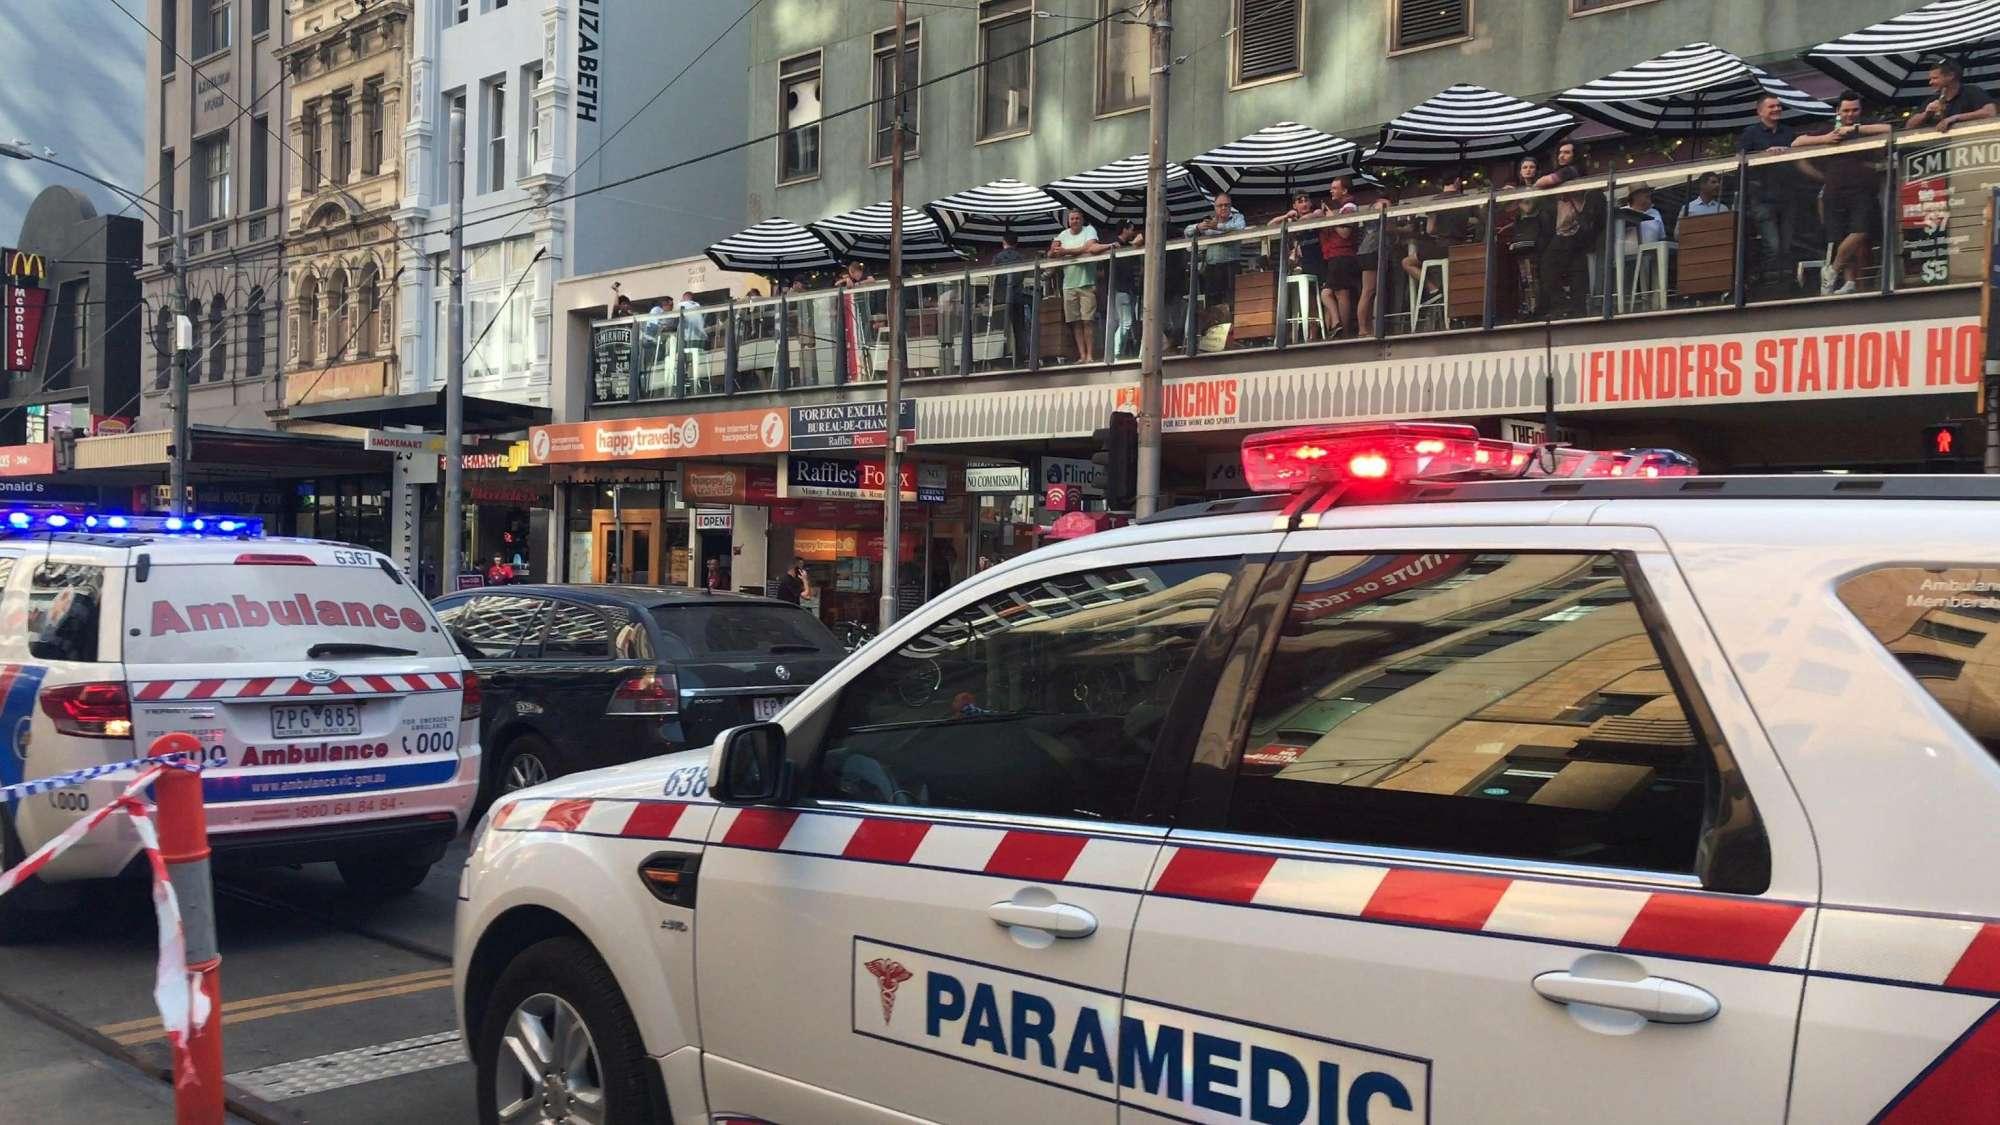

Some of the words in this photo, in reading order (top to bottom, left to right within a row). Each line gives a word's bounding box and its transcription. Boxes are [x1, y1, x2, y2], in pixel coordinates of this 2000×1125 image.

[1921, 260, 1948, 283] $5
[14, 288, 27, 366] McDonald's
[596, 330, 630, 347] SMIRNOFF
[1589, 342, 1743, 402] FLINDERS
[1755, 331, 1911, 393] STATION
[1163, 379, 1237, 418] UNCAN'S
[799, 407, 844, 422] FOREIGN
[372, 437, 423, 449] SMOKEMART
[598, 423, 681, 453] happytravels
[829, 436, 852, 446] Raffles
[797, 460, 857, 484] Raffles
[864, 465, 909, 487] Fox
[968, 475, 977, 487] NO
[978, 474, 1019, 487] COMMISSION
[801, 487, 822, 497] Money
[826, 488, 857, 498] Exchange
[703, 516, 725, 526] OPEN
[334, 550, 373, 565] 6367
[150, 593, 427, 637] Ambulance
[275, 709, 310, 730] ZPG
[324, 707, 356, 727] 885
[417, 731, 453, 753] 000
[240, 742, 389, 767] Ambulance
[251, 773, 387, 793] www.ambulance.vic.gov.au
[58, 792, 89, 811] 000
[296, 803, 328, 819] 1800
[335, 802, 351, 816] 64
[358, 800, 374, 813] 84
[380, 798, 396, 811] 84
[926, 970, 1413, 1125] PARAMEDIC
